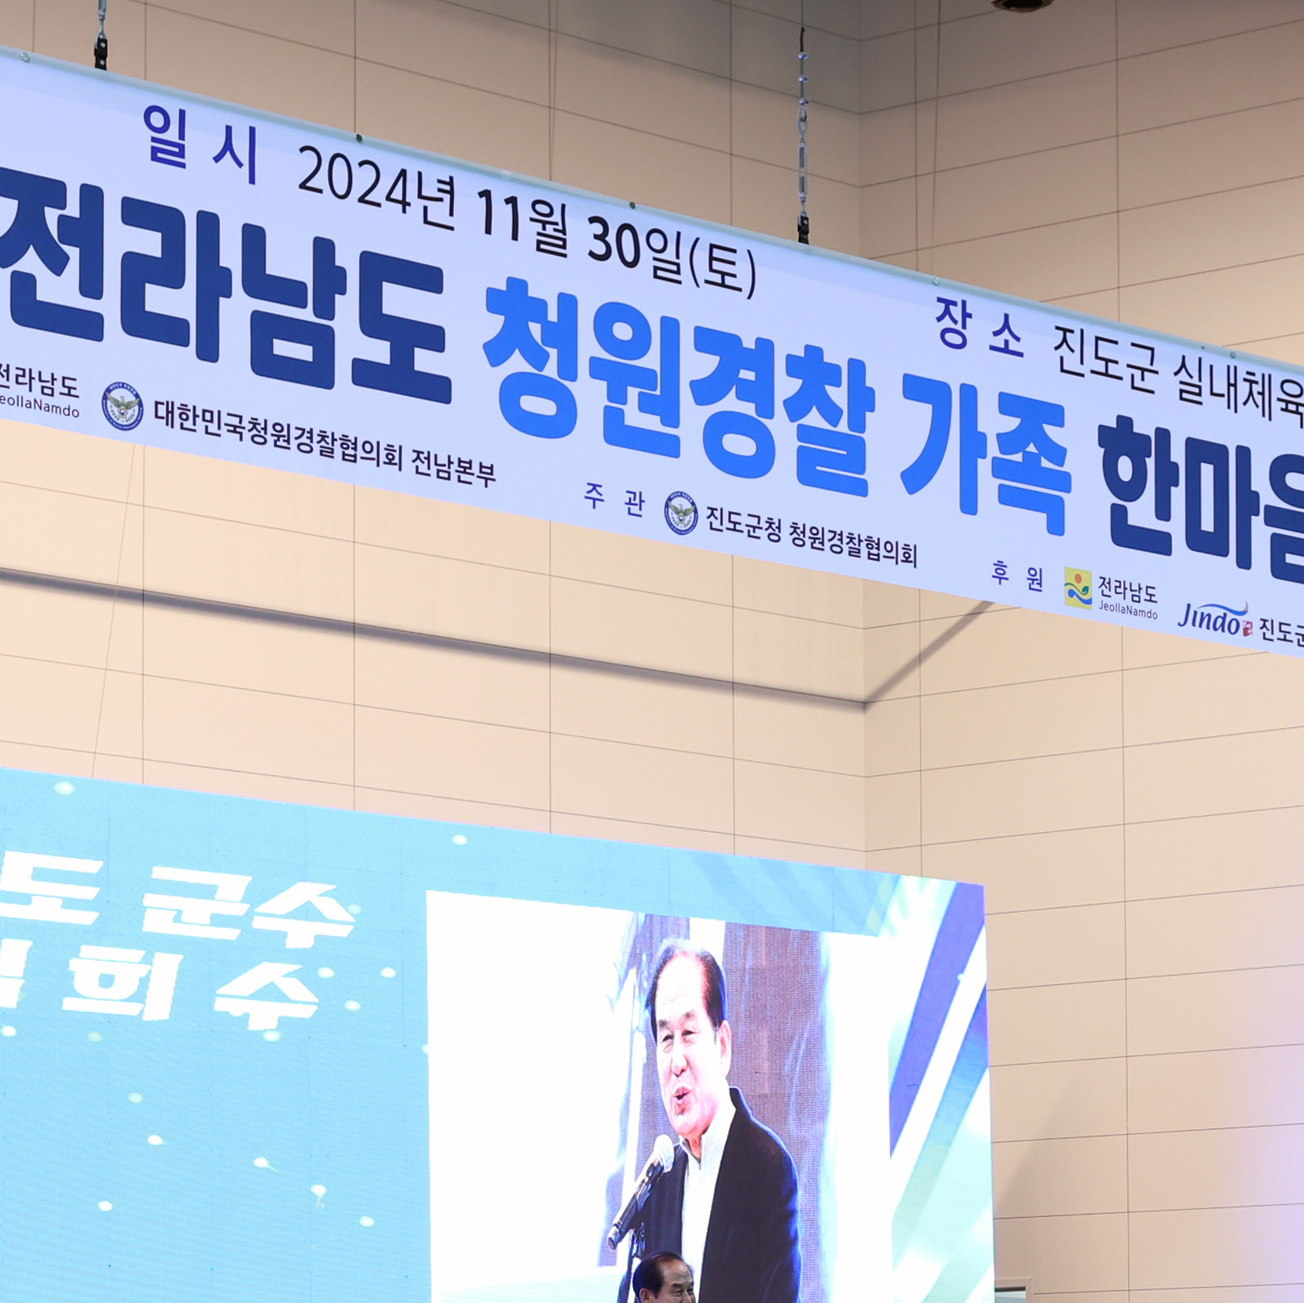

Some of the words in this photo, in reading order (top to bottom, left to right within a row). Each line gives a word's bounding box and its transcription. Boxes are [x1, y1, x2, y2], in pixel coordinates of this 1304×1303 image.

[297, 144, 457, 232] 2024년
[477, 187, 571, 259] 11월
[586, 213, 759, 301] 30일(토)
[1052, 323, 1160, 385] 진도군
[482, 276, 876, 498] 청원경찰
[899, 371, 1073, 538] 가족
[153, 399, 403, 472] 대한민국청원경찰협의회
[411, 448, 497, 489] 전남본부
[706, 505, 782, 543] 진도군청
[789, 521, 919, 569] 청원경찰협의회
[1097, 576, 1158, 605] 전라남도
[1098, 600, 1159, 620] JeollaNamdo
[1178, 602, 1243, 636] Jindo
[142, 865, 356, 949] 군수
